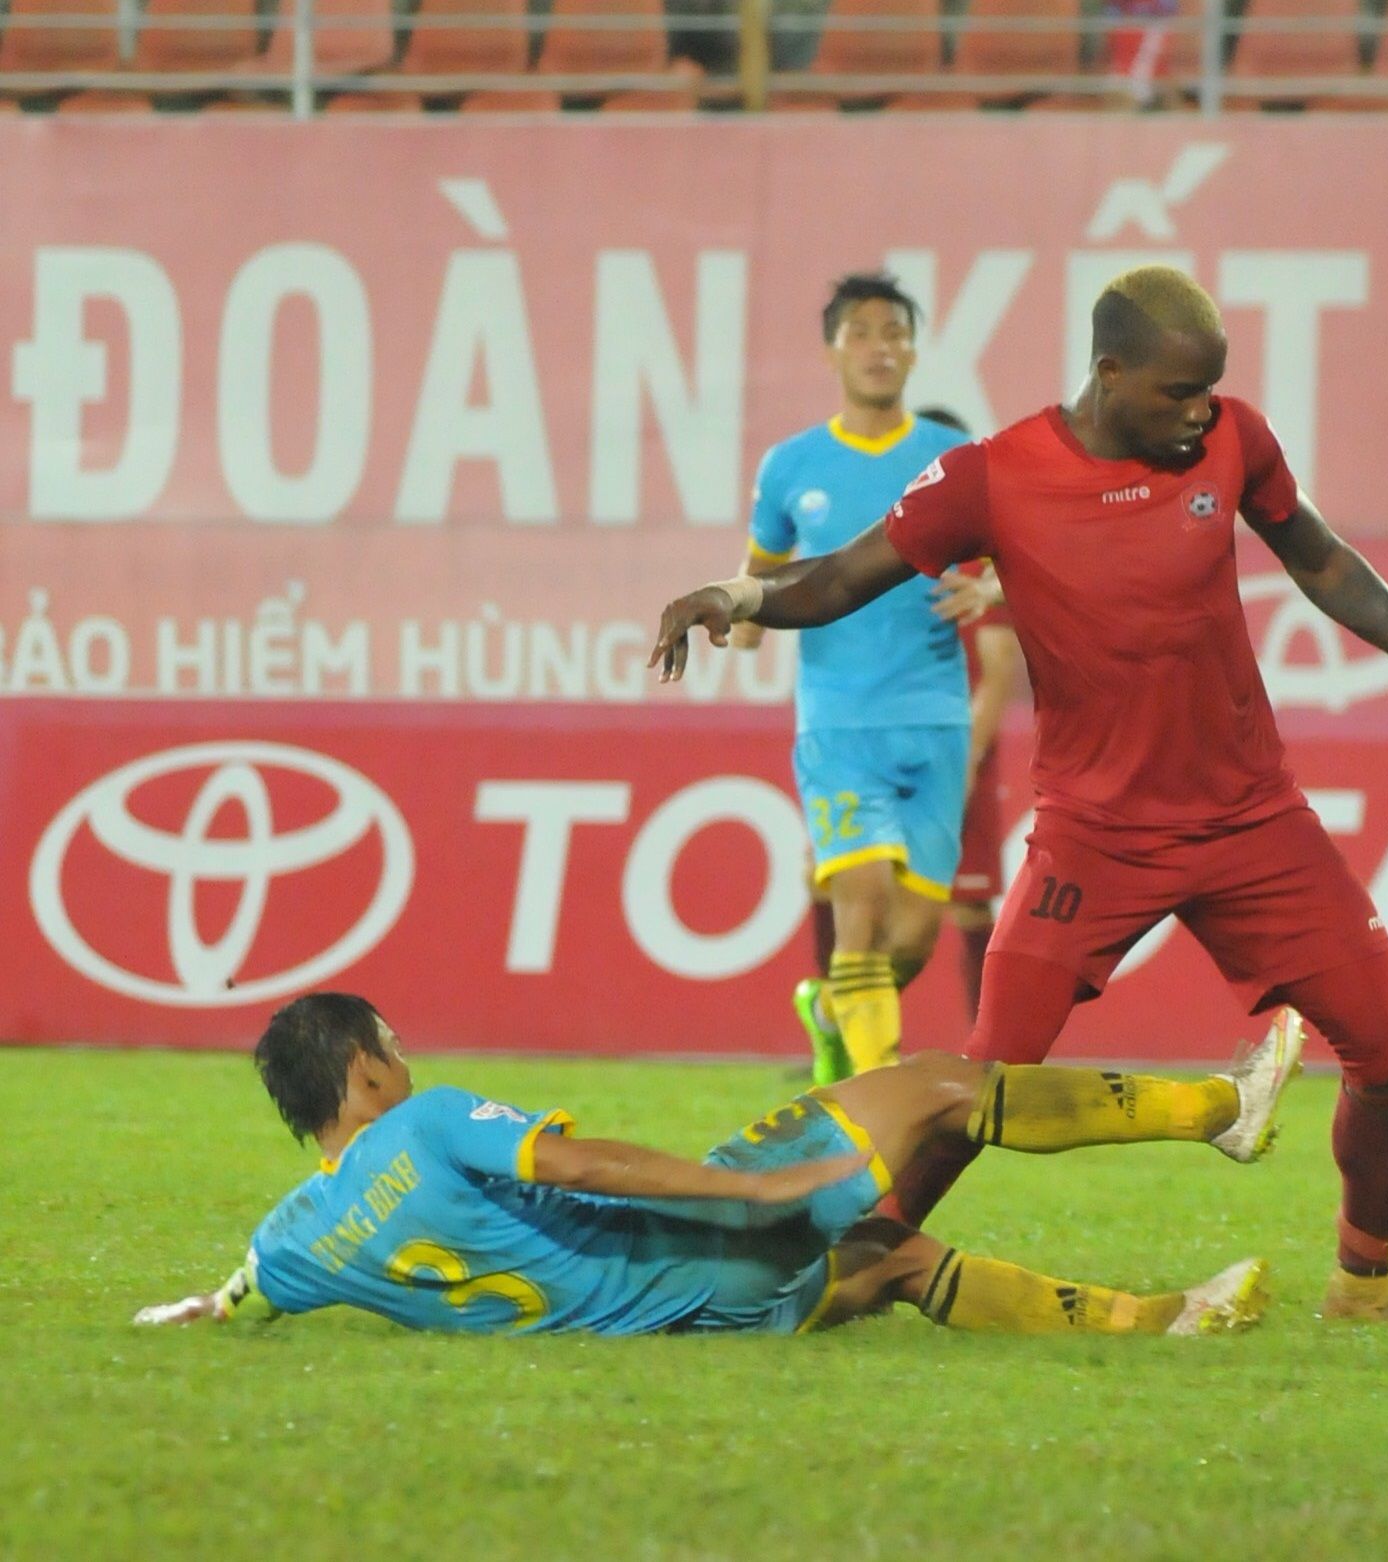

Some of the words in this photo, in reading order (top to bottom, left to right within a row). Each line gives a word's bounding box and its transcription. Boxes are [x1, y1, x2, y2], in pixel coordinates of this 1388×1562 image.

[13, 178, 748, 524] ĐOÀN
[1102, 486, 1151, 504] mitre
[0, 586, 131, 694] ẢO
[156, 578, 371, 697] HIỂM
[401, 601, 648, 701] HÙNG
[809, 790, 864, 848] 32
[1029, 876, 1083, 924] 10
